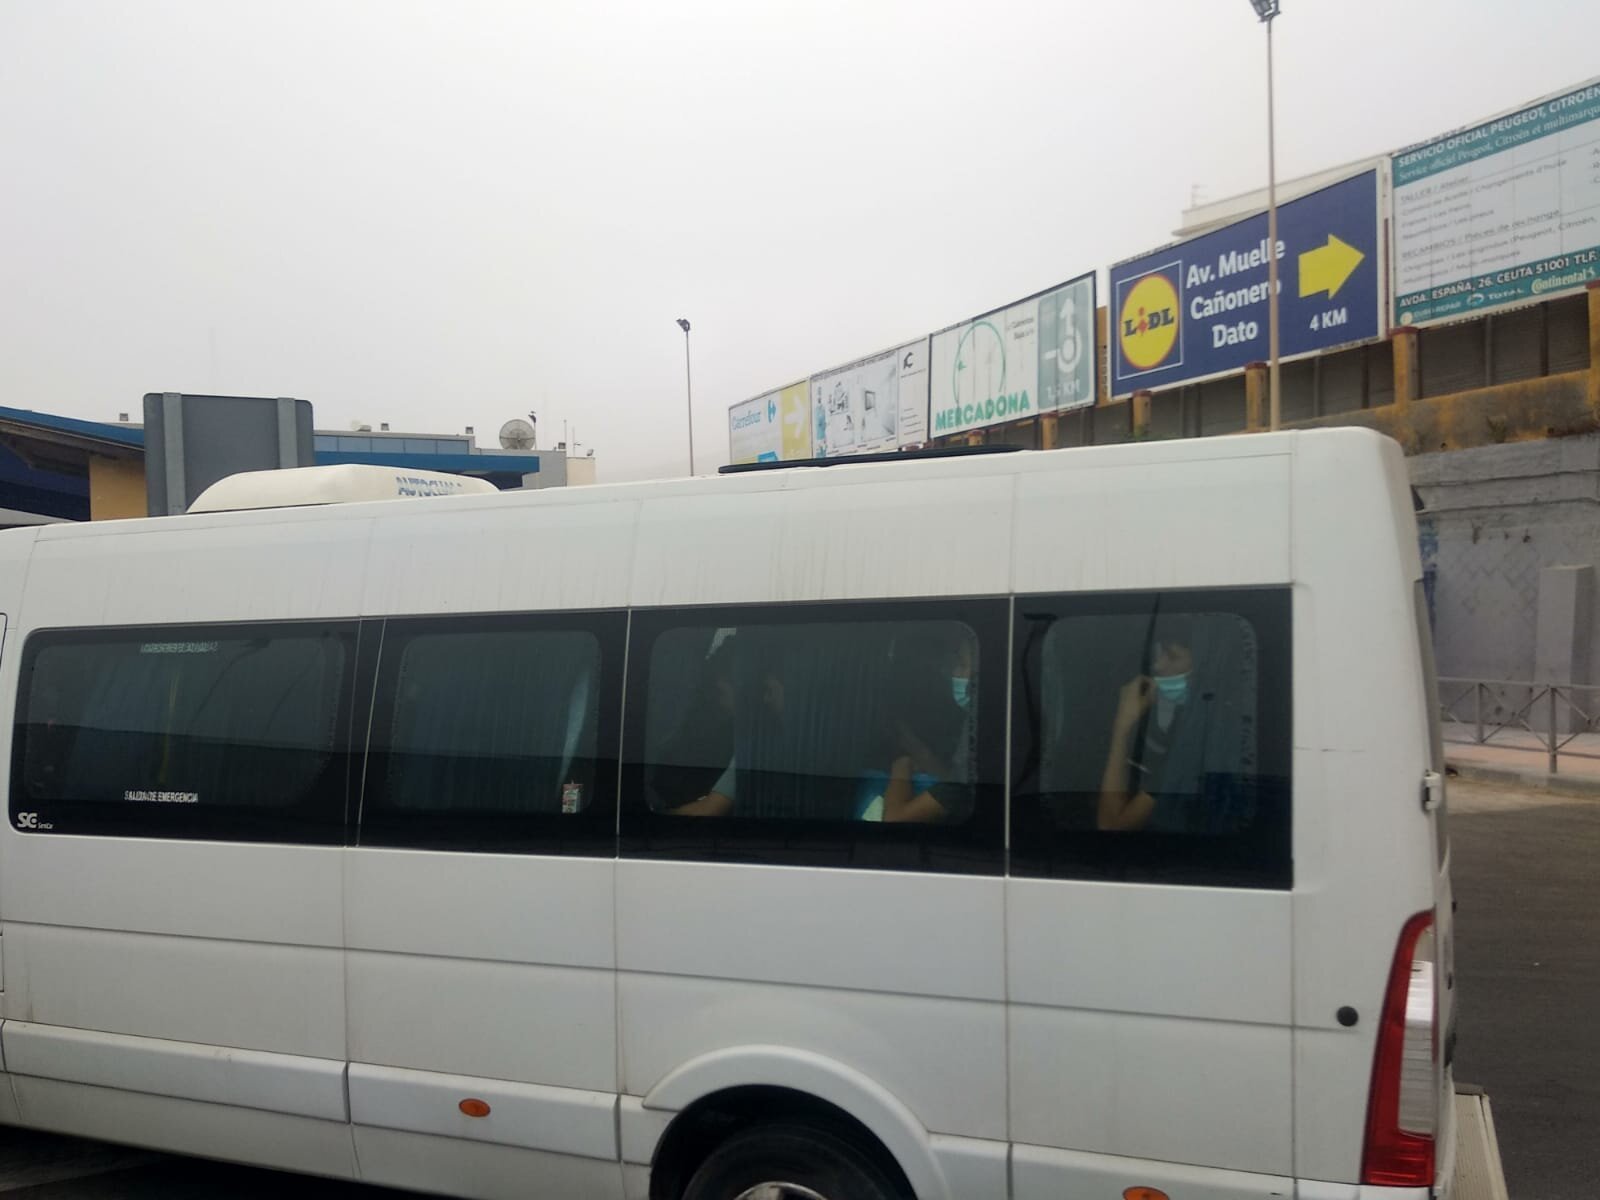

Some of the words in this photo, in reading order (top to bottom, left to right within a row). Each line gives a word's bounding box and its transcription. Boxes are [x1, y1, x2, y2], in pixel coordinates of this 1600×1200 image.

[1399, 143, 1444, 167] SERVICIO
[1447, 128, 1488, 149] OFICIAL
[1185, 263, 1216, 288] Av.
[1497, 267, 1533, 283] CEUTA
[1536, 258, 1569, 274] 51001
[1309, 314, 1319, 331] 4
[1322, 307, 1348, 329] KM
[1212, 321, 1259, 348] Dato
[935, 389, 1030, 431] MERCADONA
